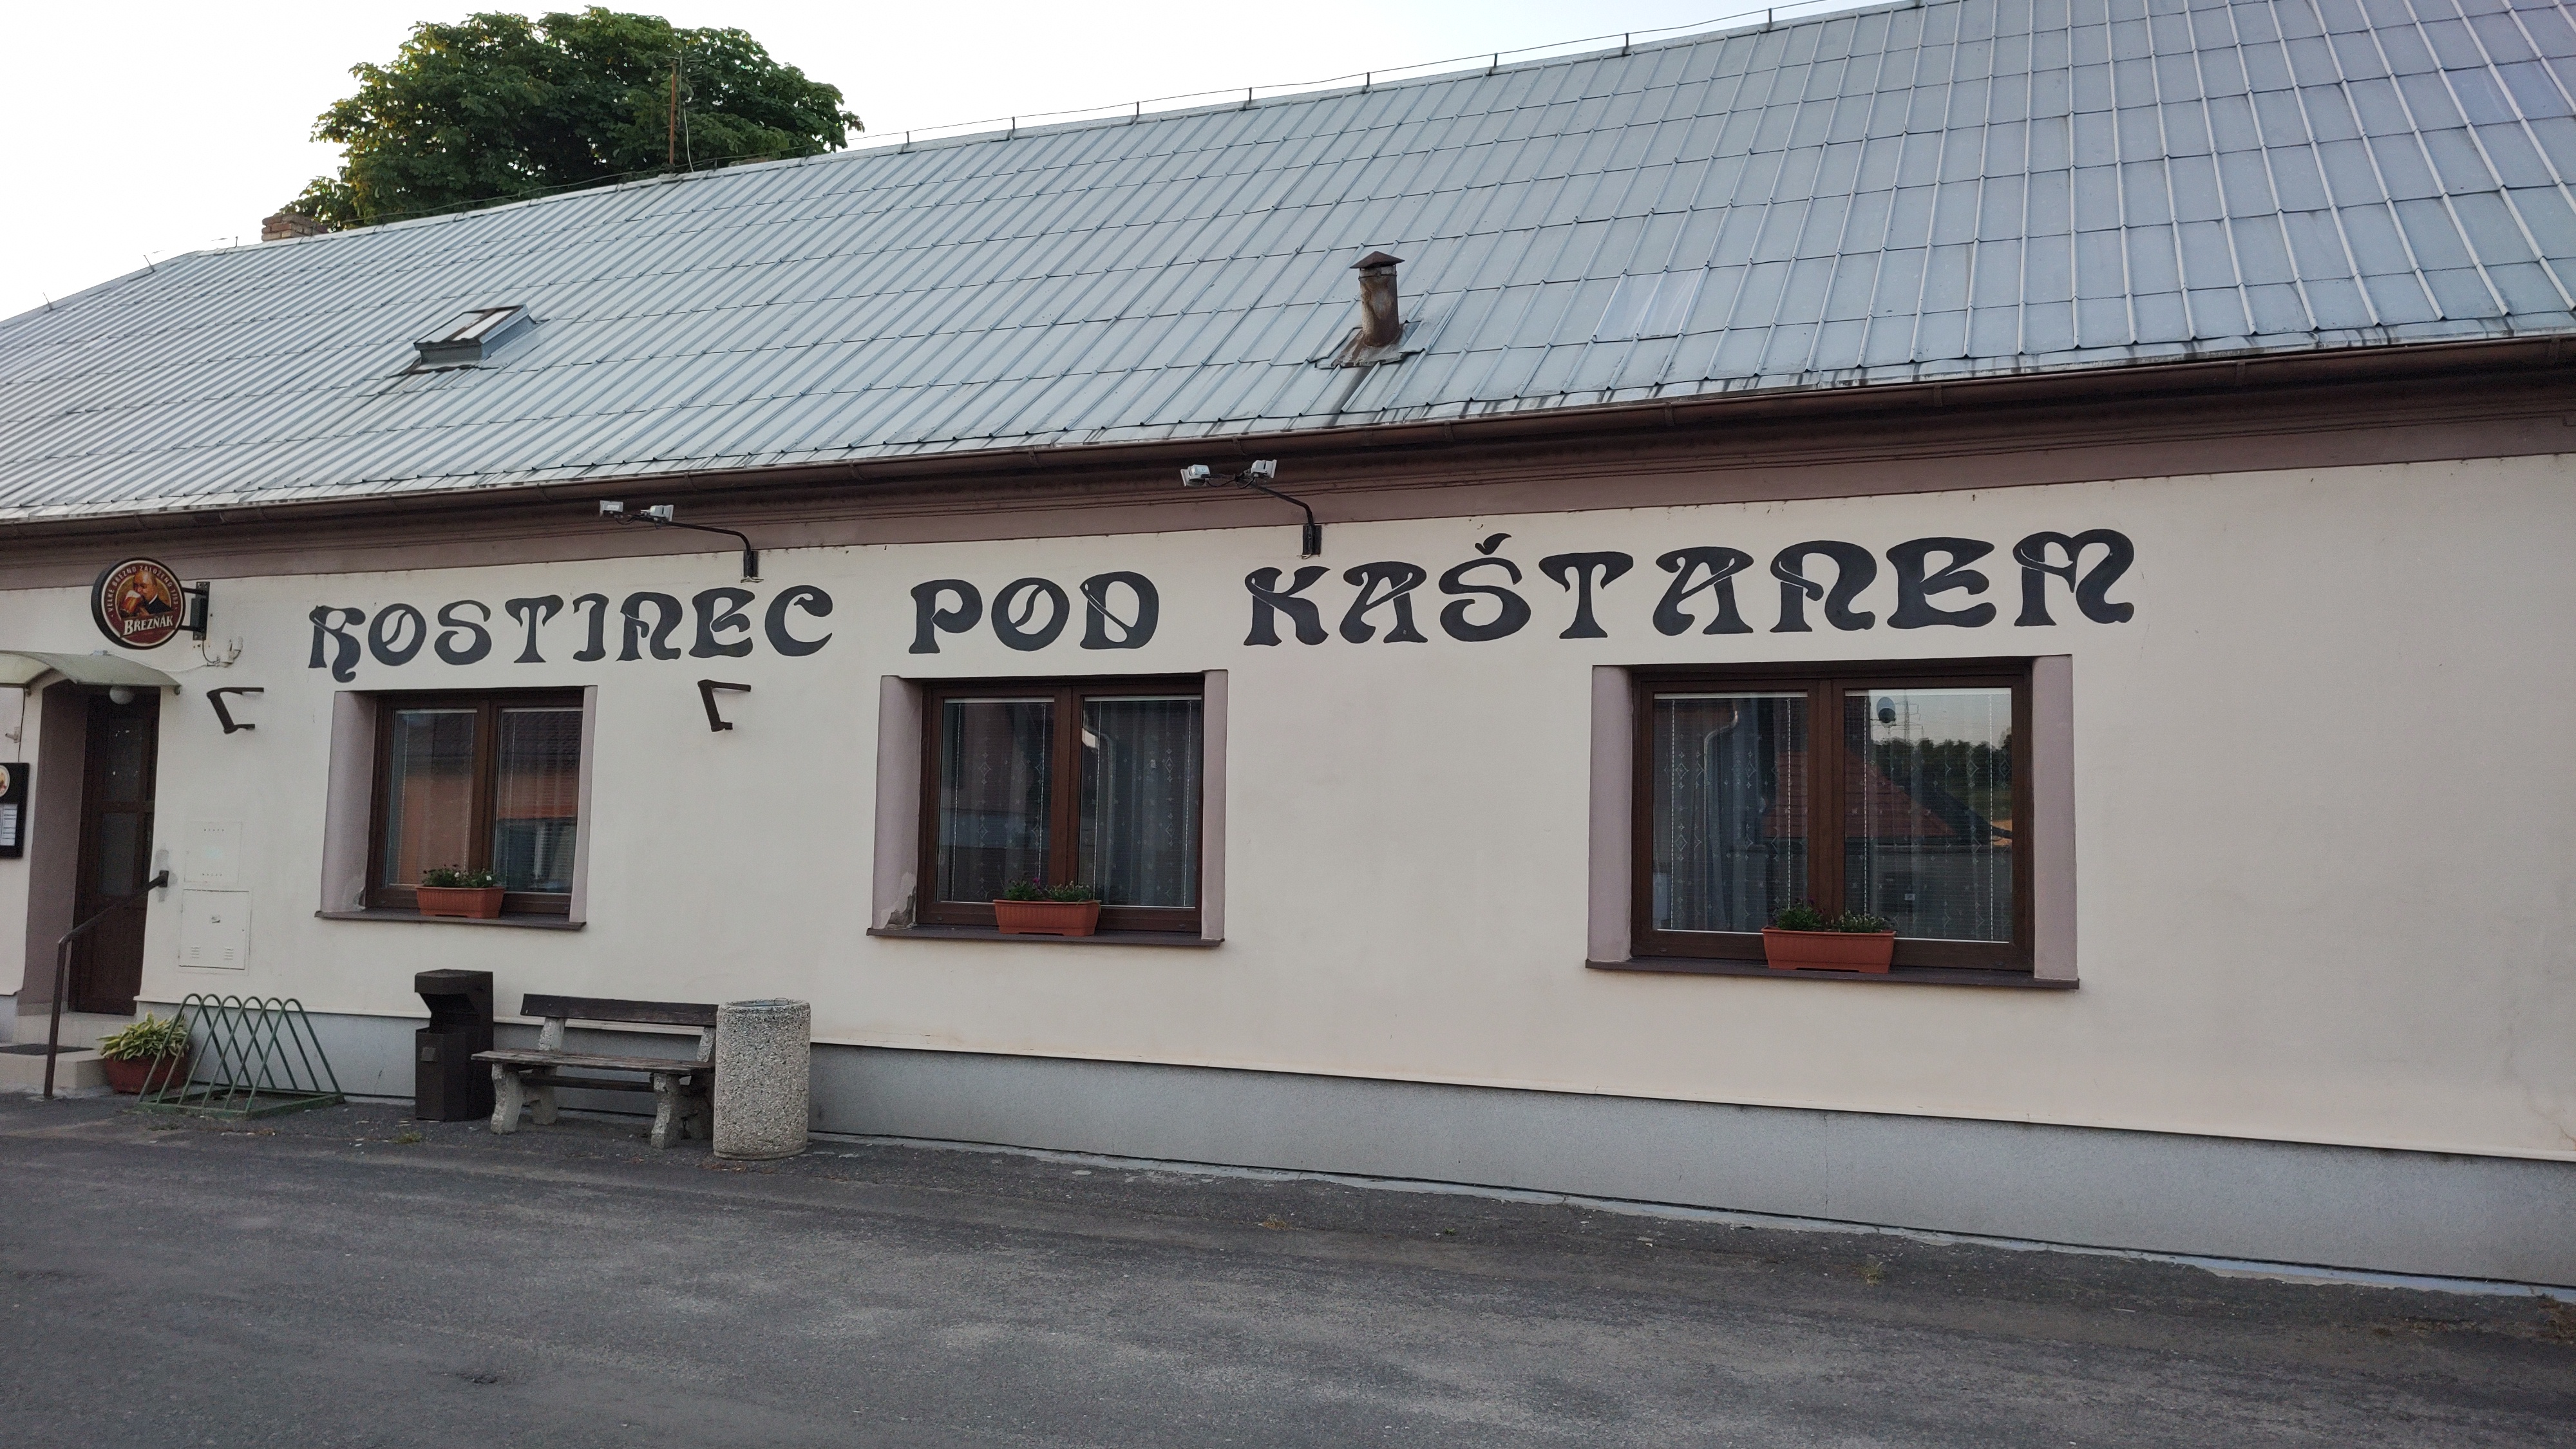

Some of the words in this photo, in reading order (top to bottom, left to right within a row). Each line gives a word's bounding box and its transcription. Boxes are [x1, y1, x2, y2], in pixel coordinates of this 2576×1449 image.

[123, 614, 173, 636] BŘEZŇÁK
[908, 571, 1159, 654] POD
[1243, 528, 2135, 646] KAŠTANEM
